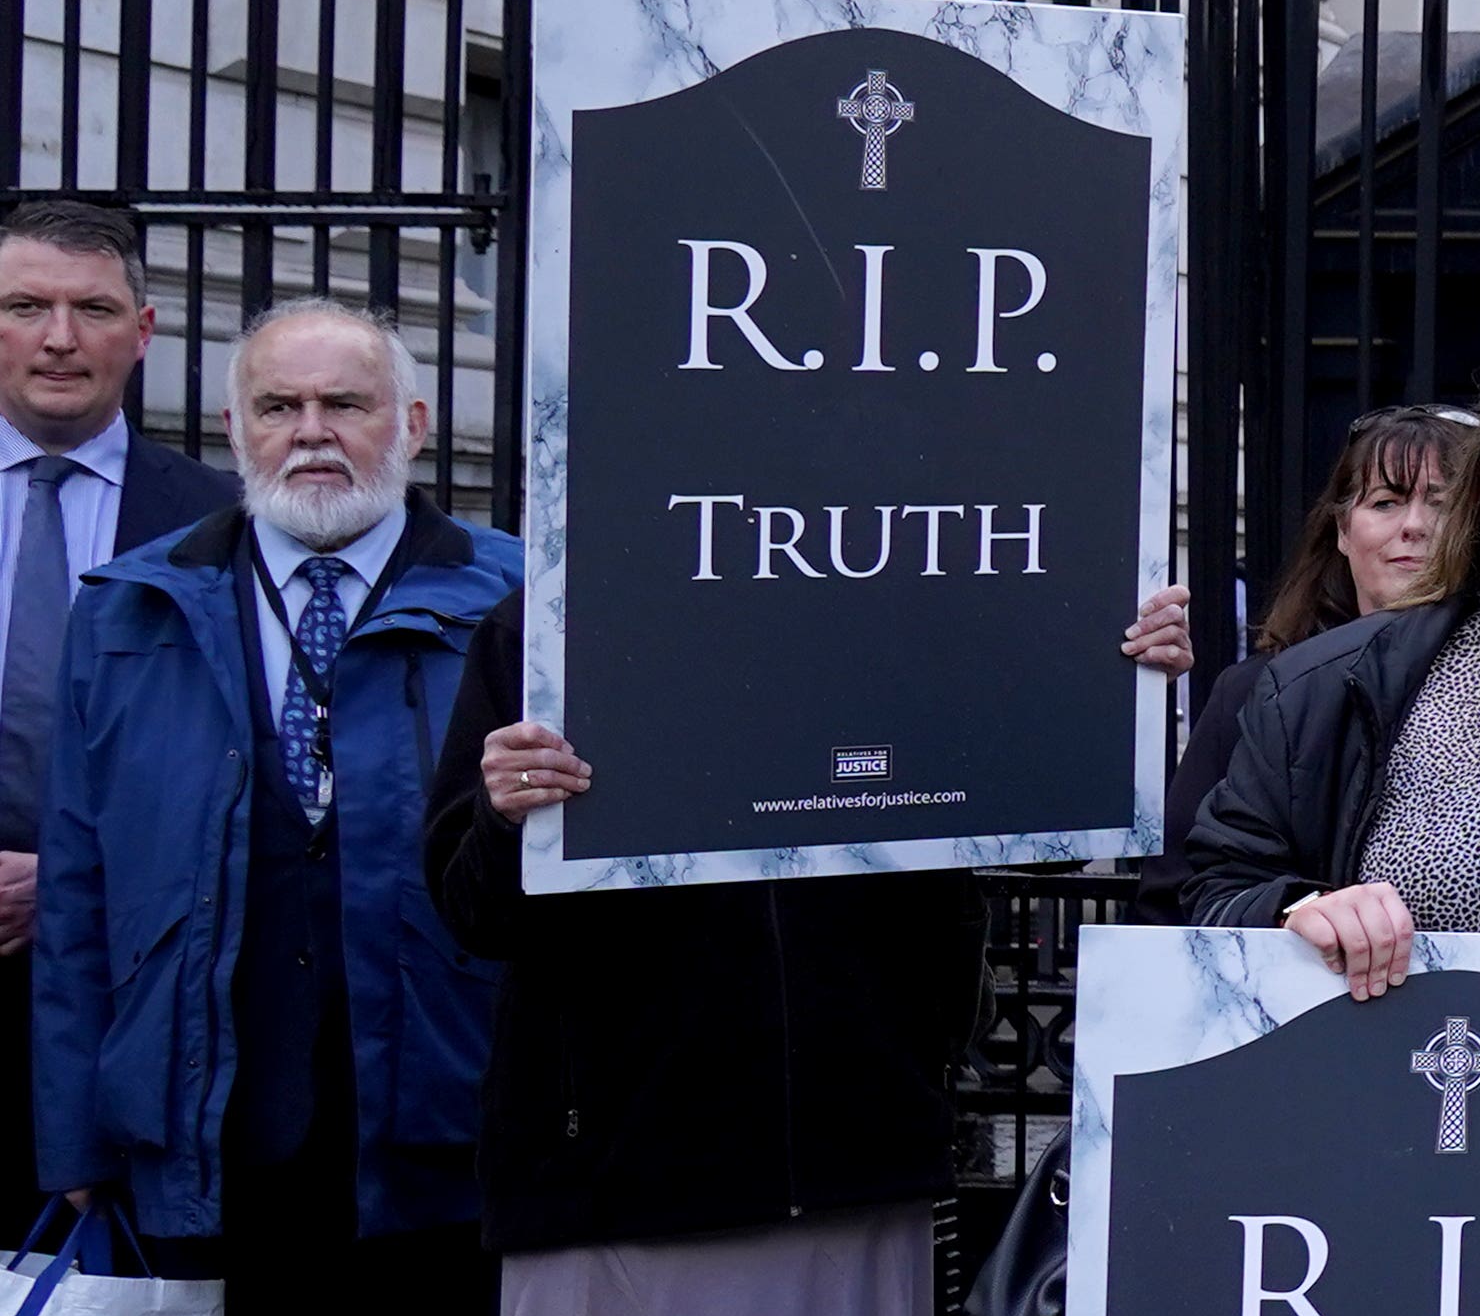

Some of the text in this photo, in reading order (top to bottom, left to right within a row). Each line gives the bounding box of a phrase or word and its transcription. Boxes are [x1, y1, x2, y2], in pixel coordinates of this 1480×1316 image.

[677, 240, 1058, 373] R.I.P.
[836, 760, 887, 773] JUSTICE
[752, 790, 966, 813] www.relativesforjustice.com
